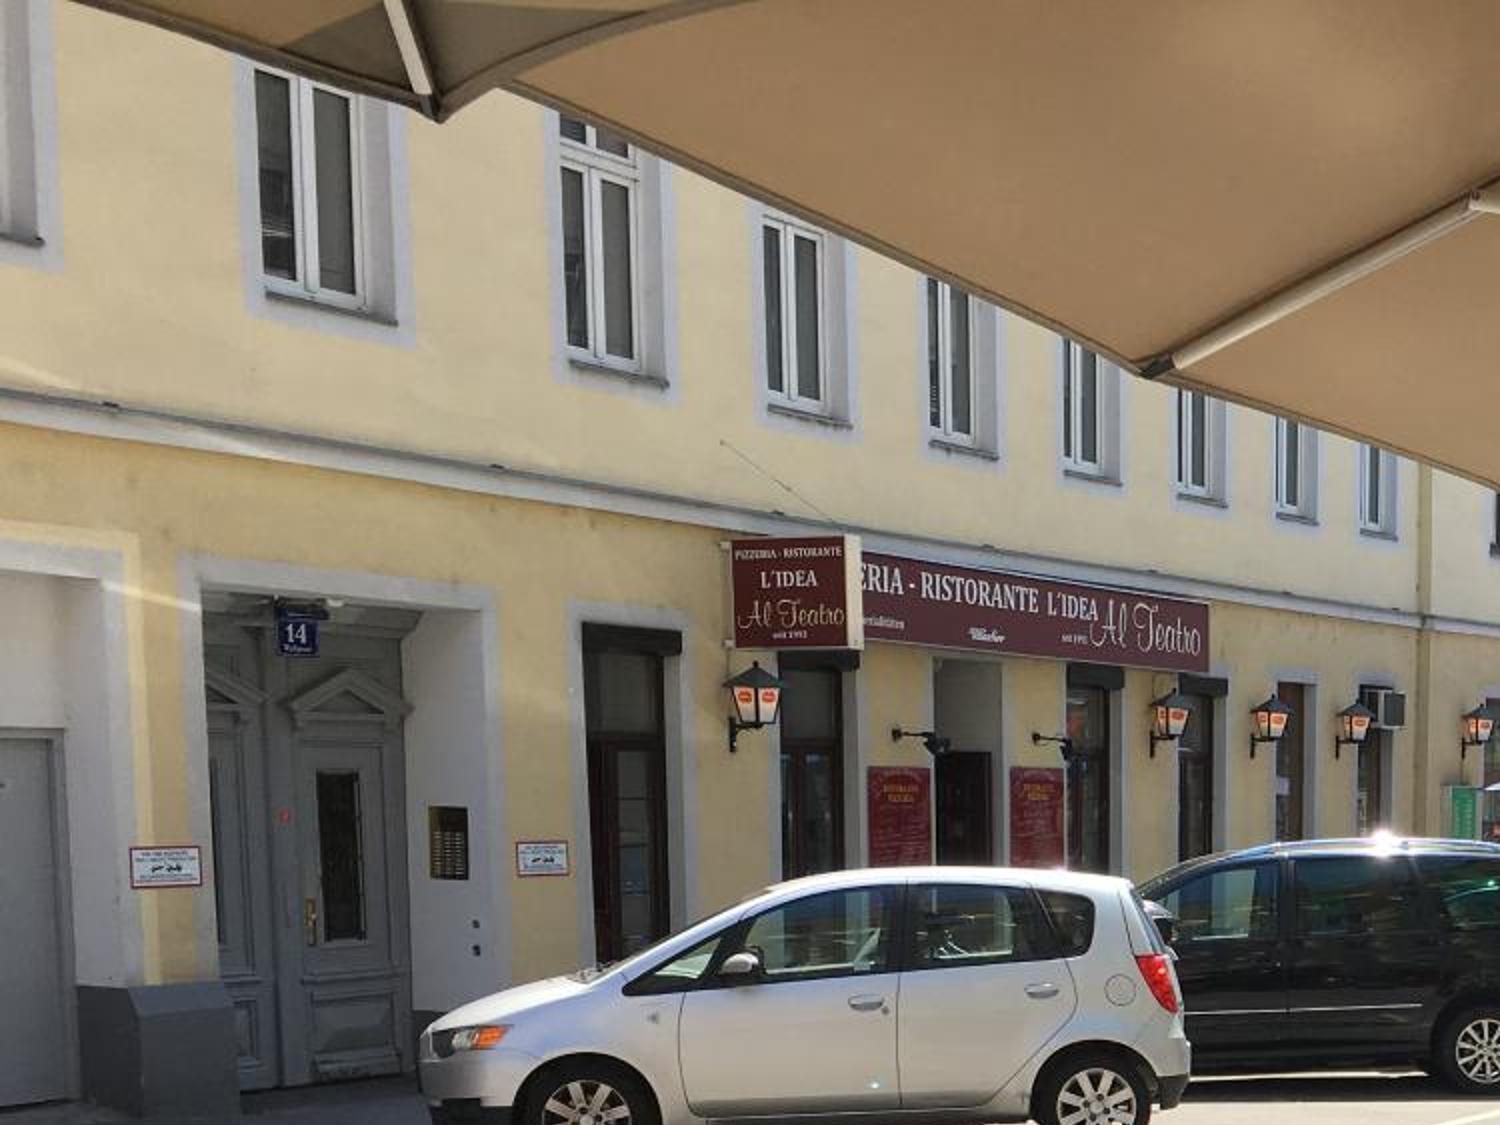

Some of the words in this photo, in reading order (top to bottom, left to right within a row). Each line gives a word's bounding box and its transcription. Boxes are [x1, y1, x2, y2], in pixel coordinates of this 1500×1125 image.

[737, 600, 771, 629] Al
[776, 599, 845, 629] Teatro
[921, 571, 1038, 613] RISTORANTE
[1090, 599, 1127, 648] Al
[1132, 602, 1201, 657] Teatro
[285, 623, 307, 644] 14
